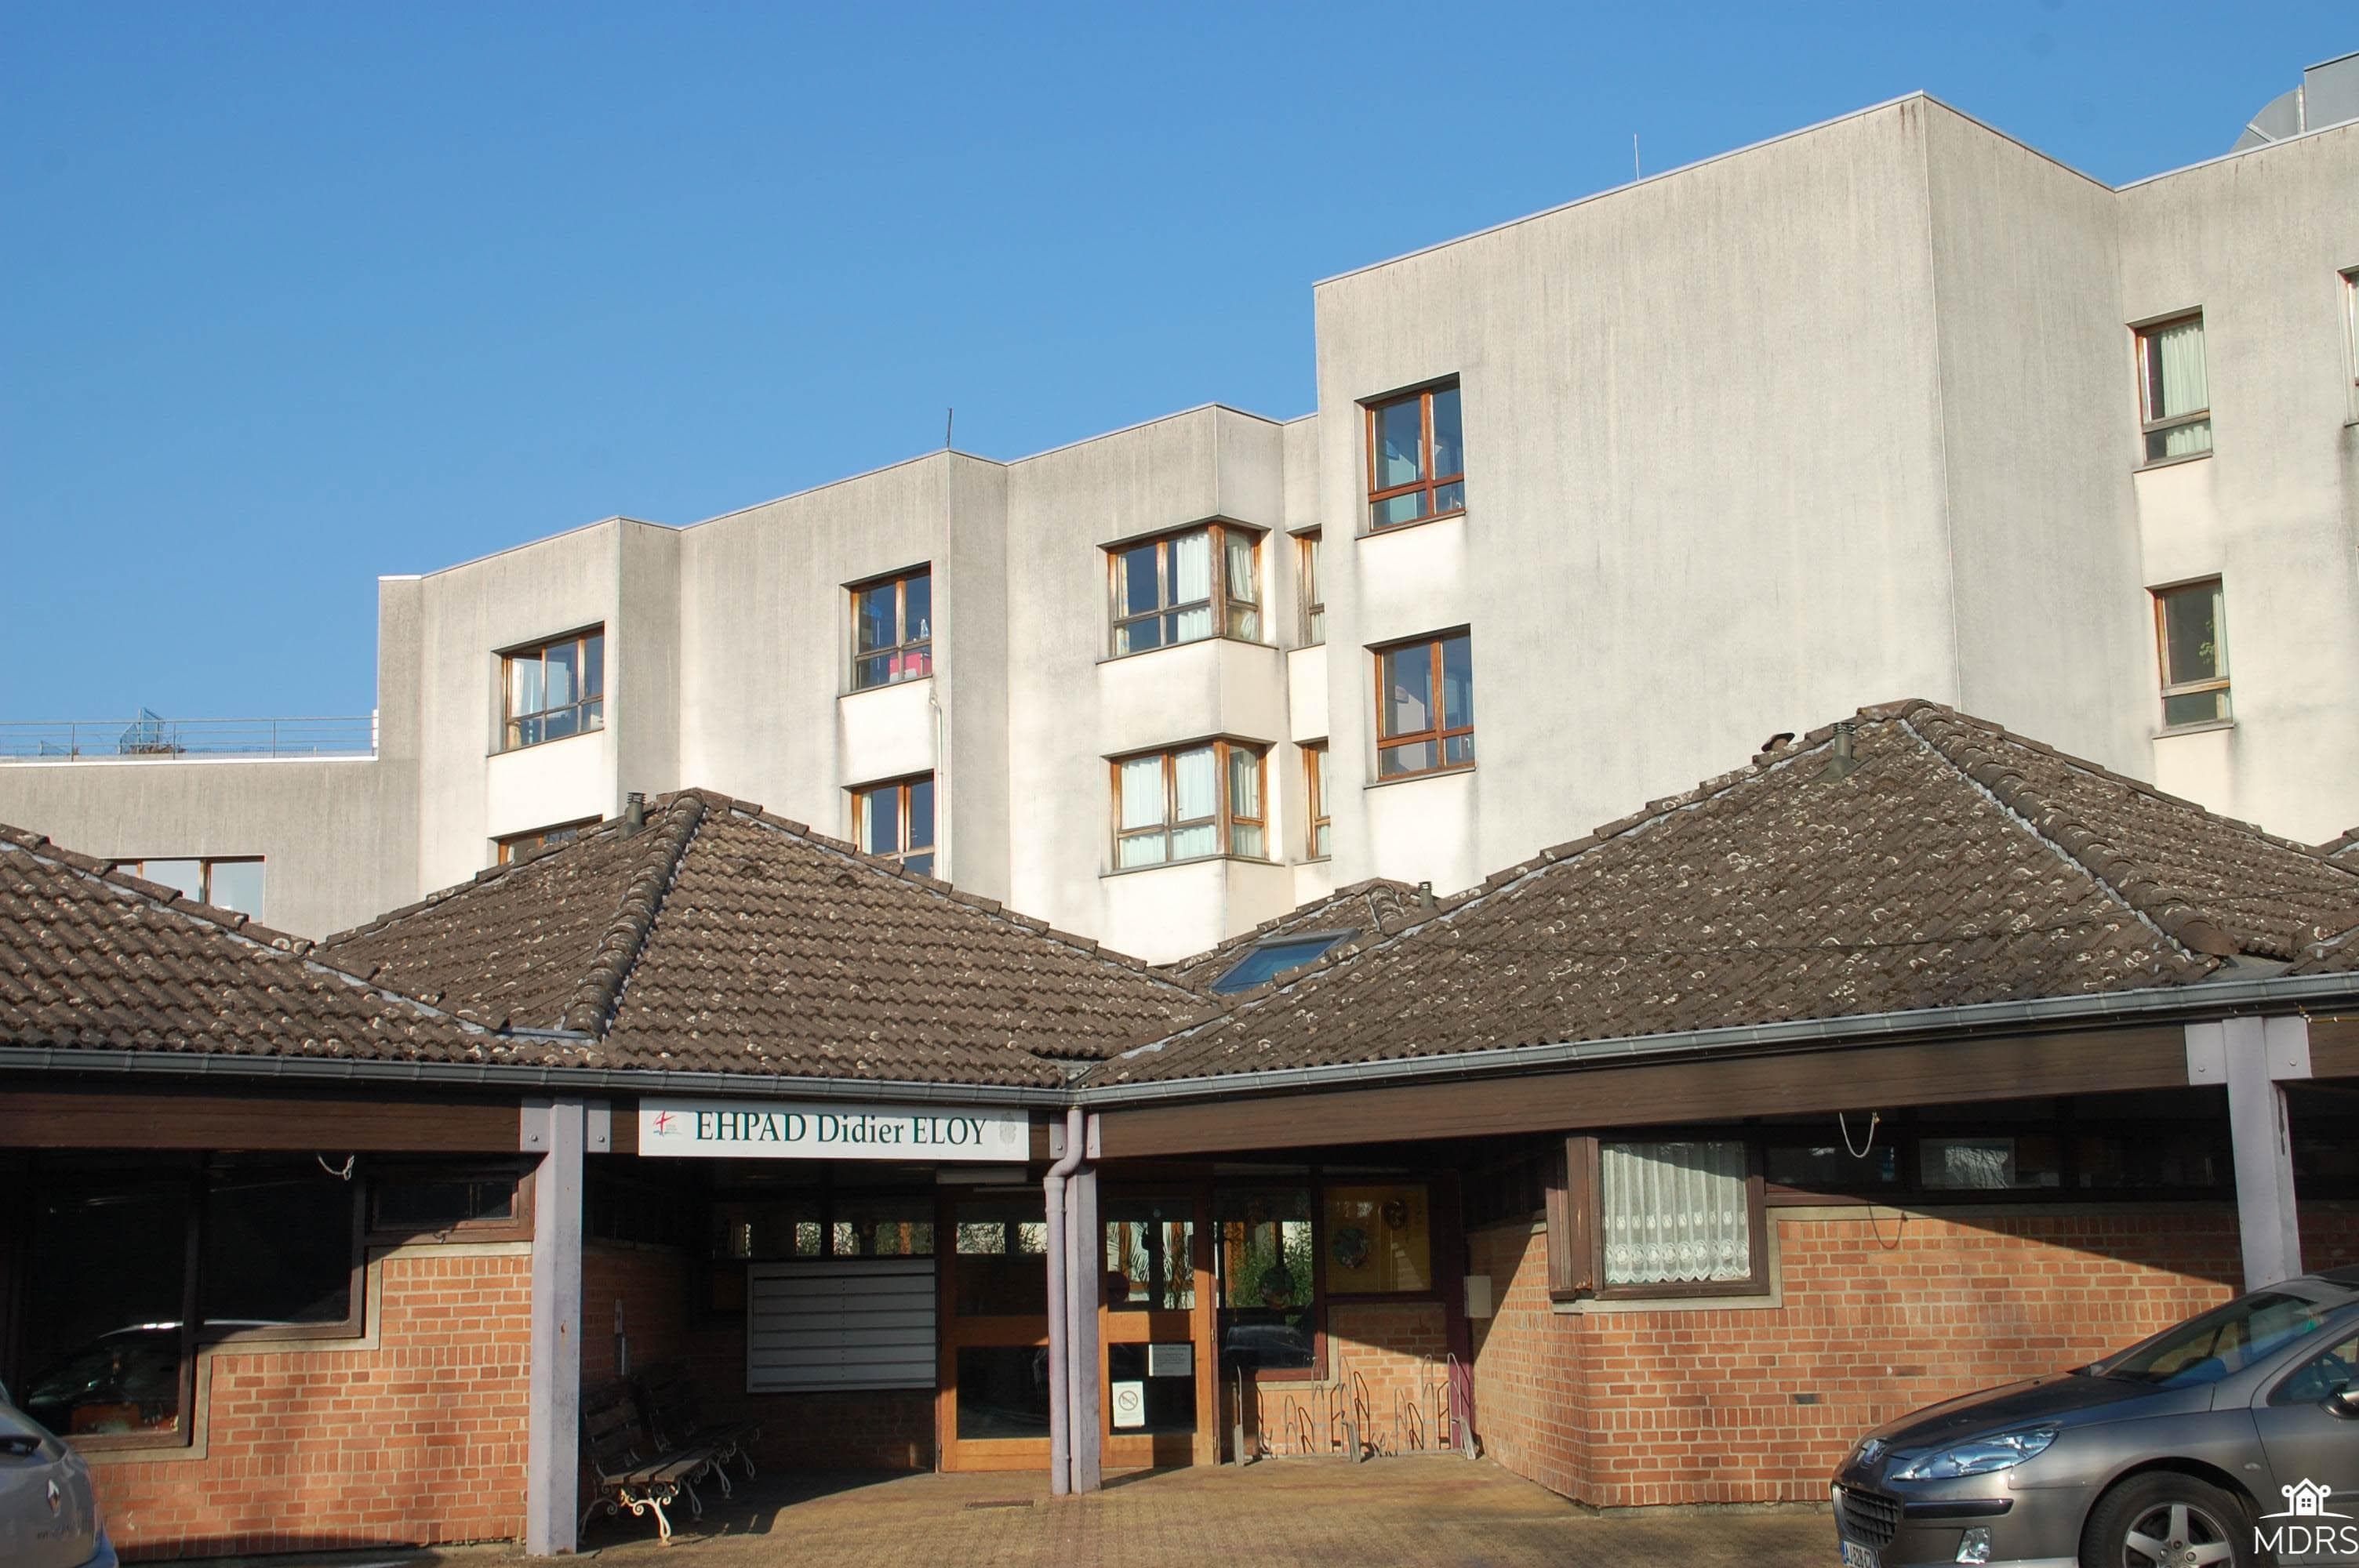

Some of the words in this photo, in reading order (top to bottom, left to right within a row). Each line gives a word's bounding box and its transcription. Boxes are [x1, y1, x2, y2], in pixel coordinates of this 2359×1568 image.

[696, 1110, 806, 1142] EHPAD
[816, 1113, 903, 1144] Didier
[912, 1116, 987, 1145] ELOY
